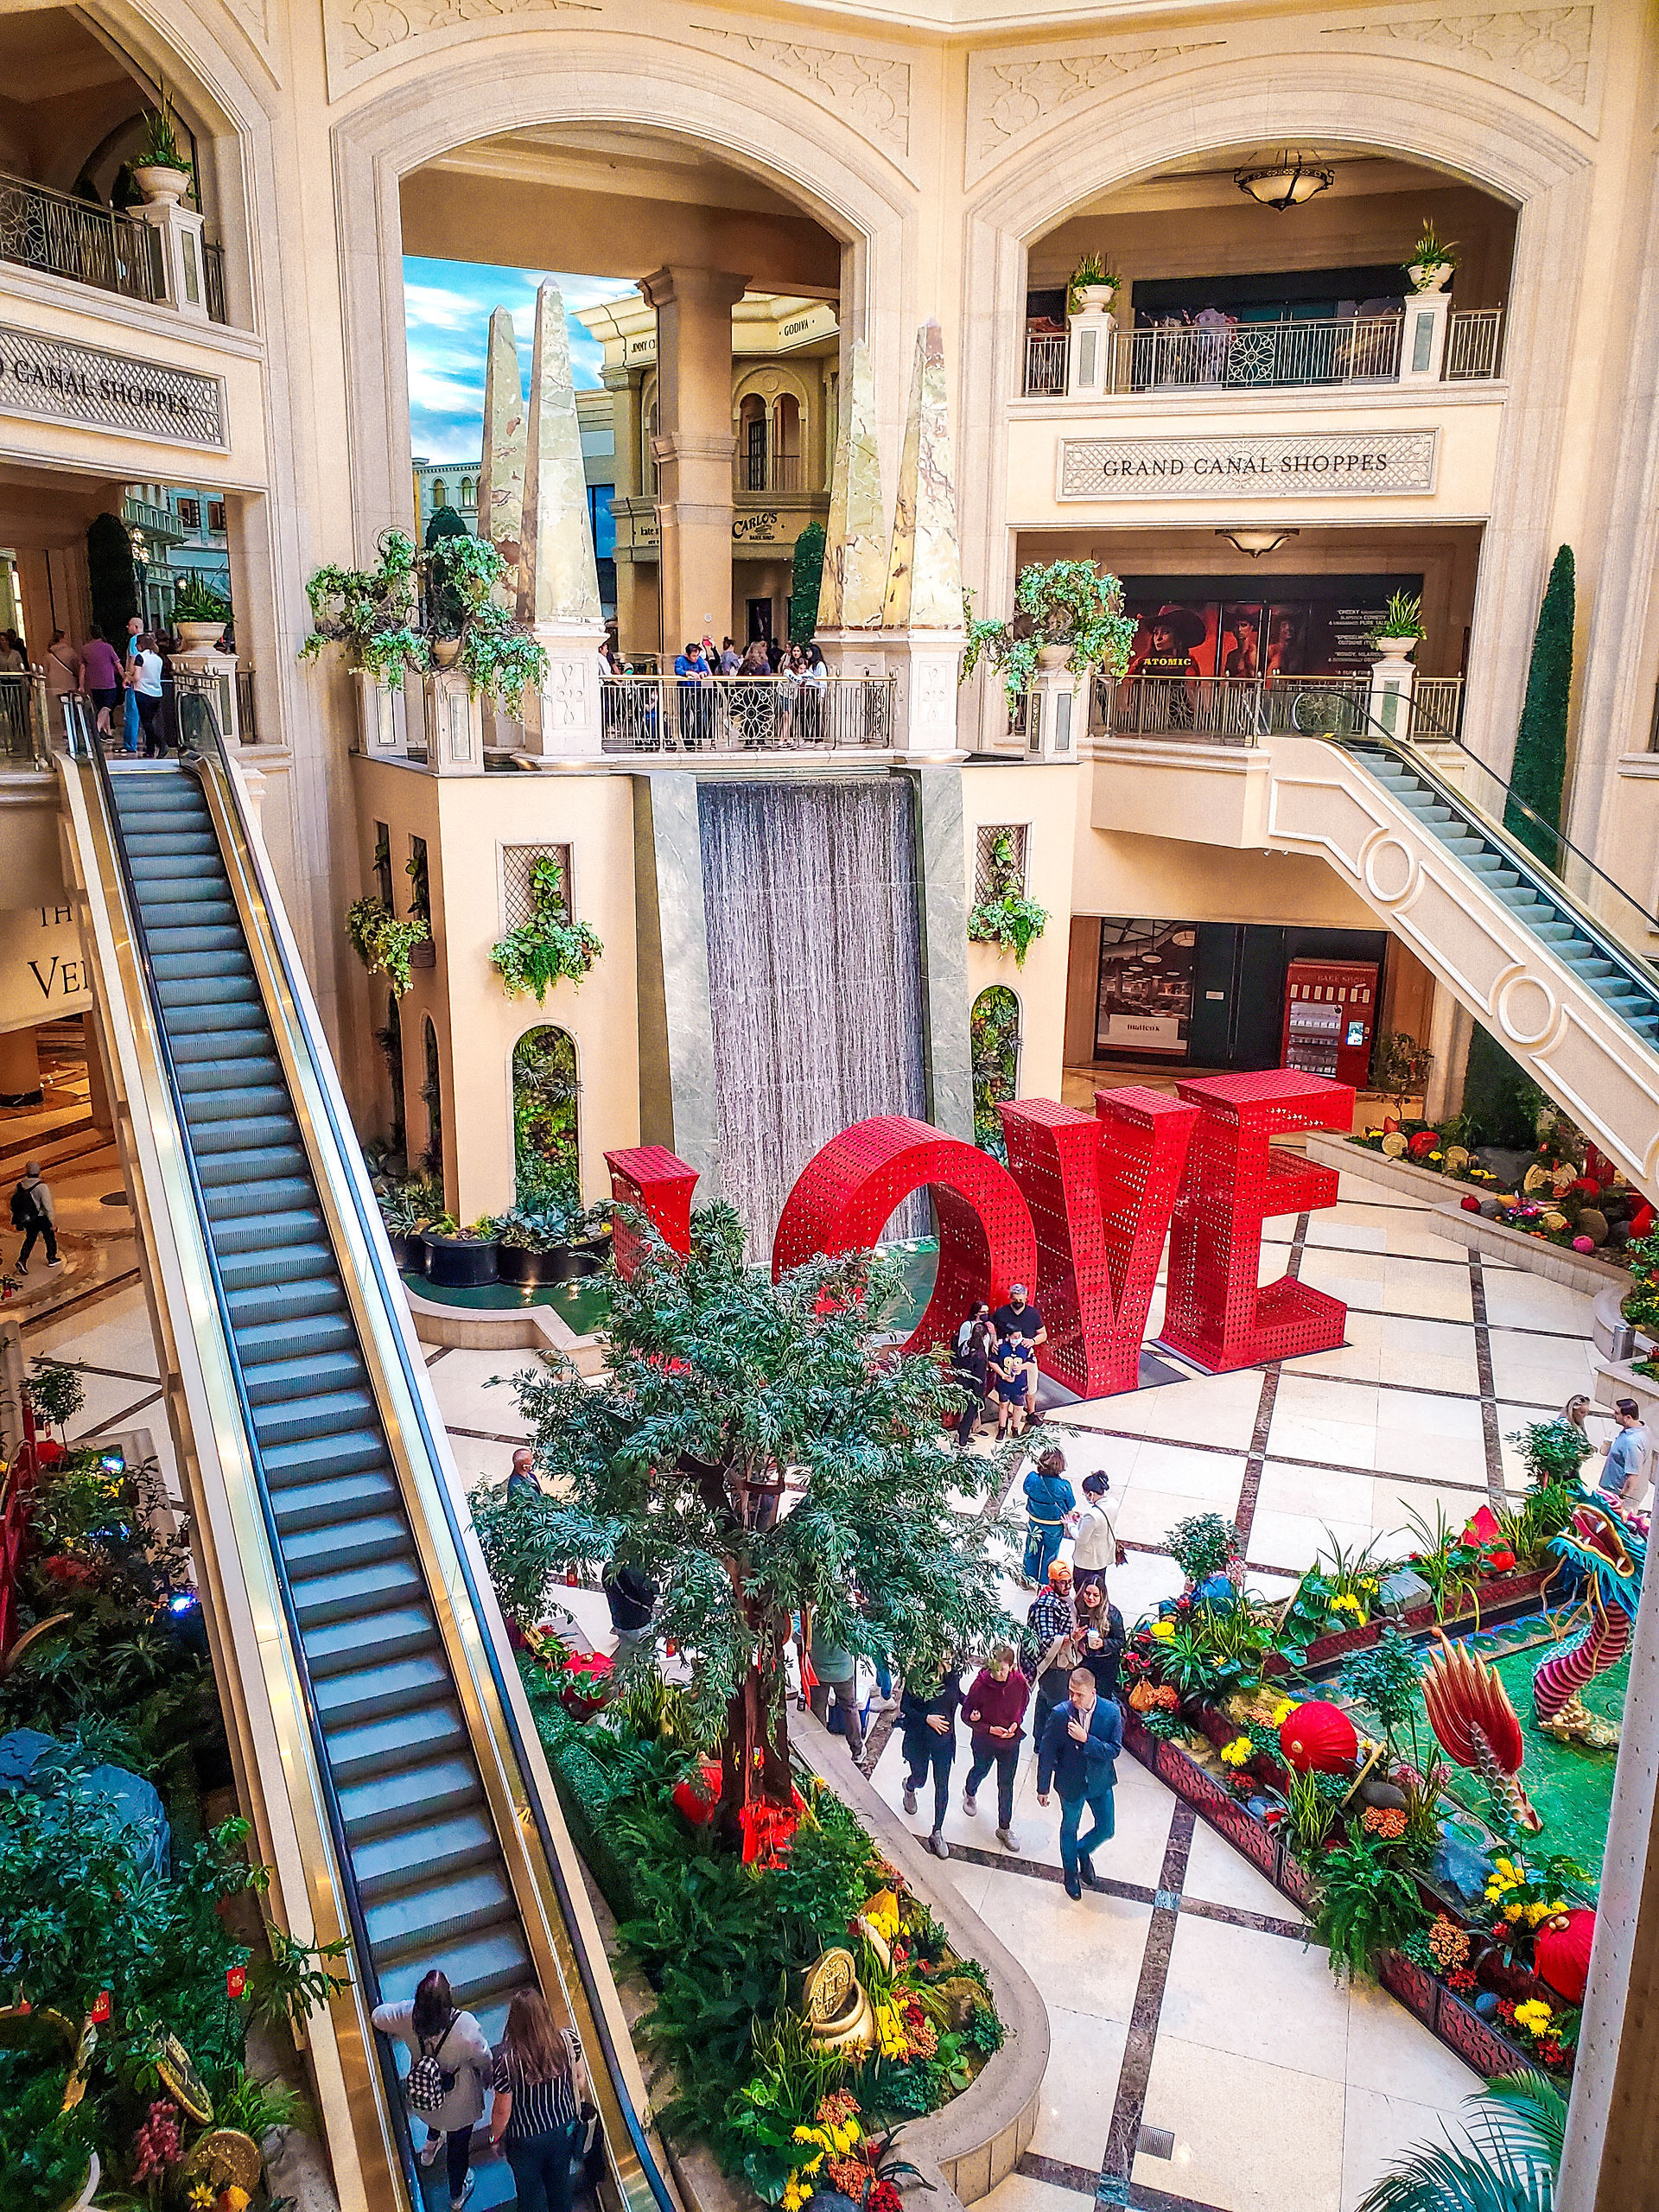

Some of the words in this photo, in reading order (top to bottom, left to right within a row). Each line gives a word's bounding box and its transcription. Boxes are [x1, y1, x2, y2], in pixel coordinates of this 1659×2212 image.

[784, 318, 810, 337] GODIVA
[14, 359, 95, 397] CANAL
[99, 378, 190, 416] SHOPPES
[1103, 459, 1185, 476] GRAND
[1193, 456, 1274, 474] CANAL
[1281, 454, 1389, 473] SHOPPES
[732, 512, 779, 539] CARLO'S
[1143, 658, 1192, 666] ATOMIC
